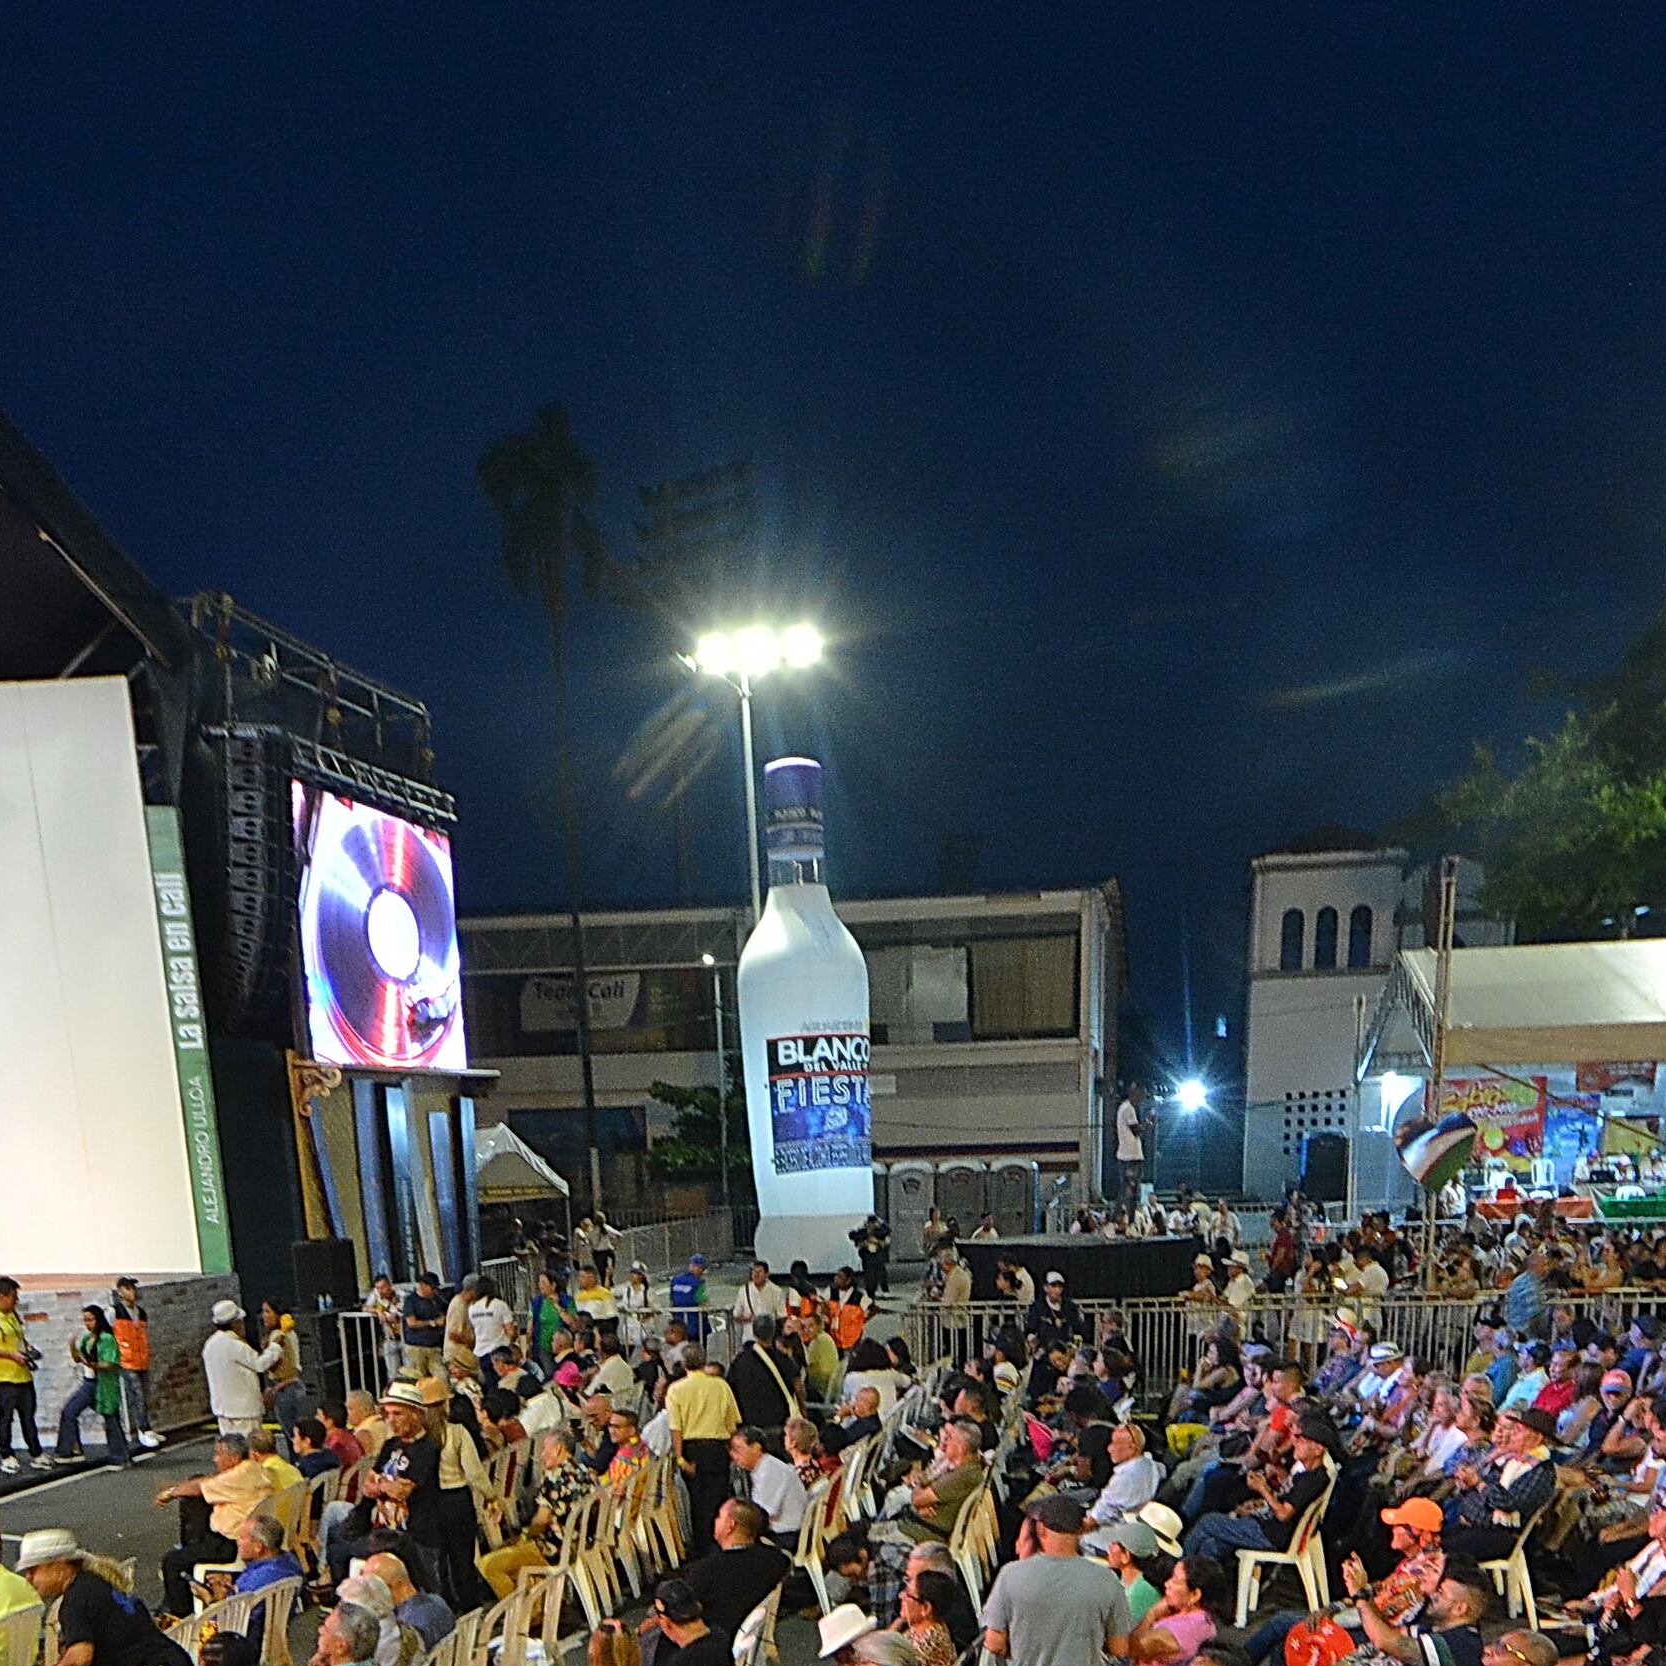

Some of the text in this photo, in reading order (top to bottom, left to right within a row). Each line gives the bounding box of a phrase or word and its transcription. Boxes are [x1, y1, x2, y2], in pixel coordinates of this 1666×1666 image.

[164, 922, 192, 951] en
[169, 956, 200, 1019] salsa
[588, 980, 625, 998] Cali
[177, 1023, 204, 1050] La
[777, 1035, 871, 1066] BLANCO
[804, 1061, 829, 1073] DEL
[188, 1075, 220, 1224] ALEJANDRO ULLOA
